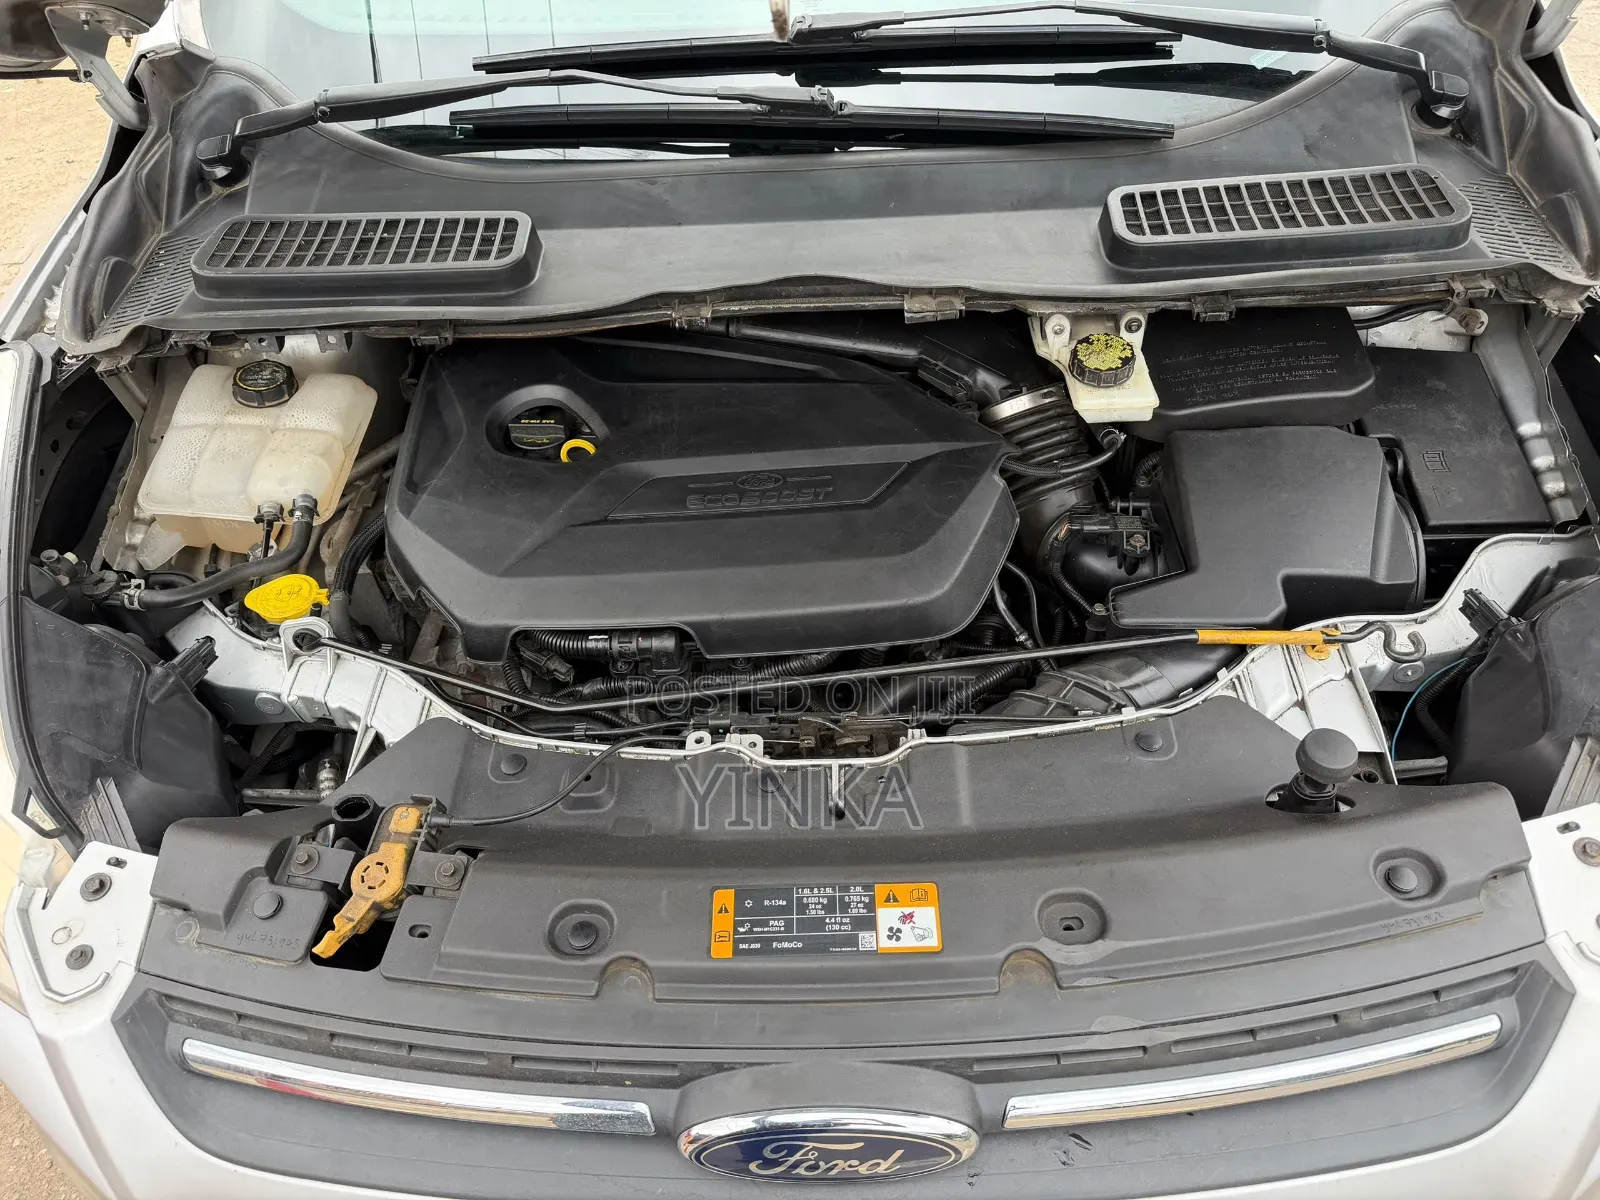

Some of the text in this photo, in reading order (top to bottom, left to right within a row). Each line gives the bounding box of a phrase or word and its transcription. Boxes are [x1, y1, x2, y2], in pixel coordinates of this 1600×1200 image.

[819, 896, 828, 905] kg
[861, 895, 870, 904] kg
[772, 941, 803, 949] FoMoCo
[748, 1140, 905, 1176] Ford
